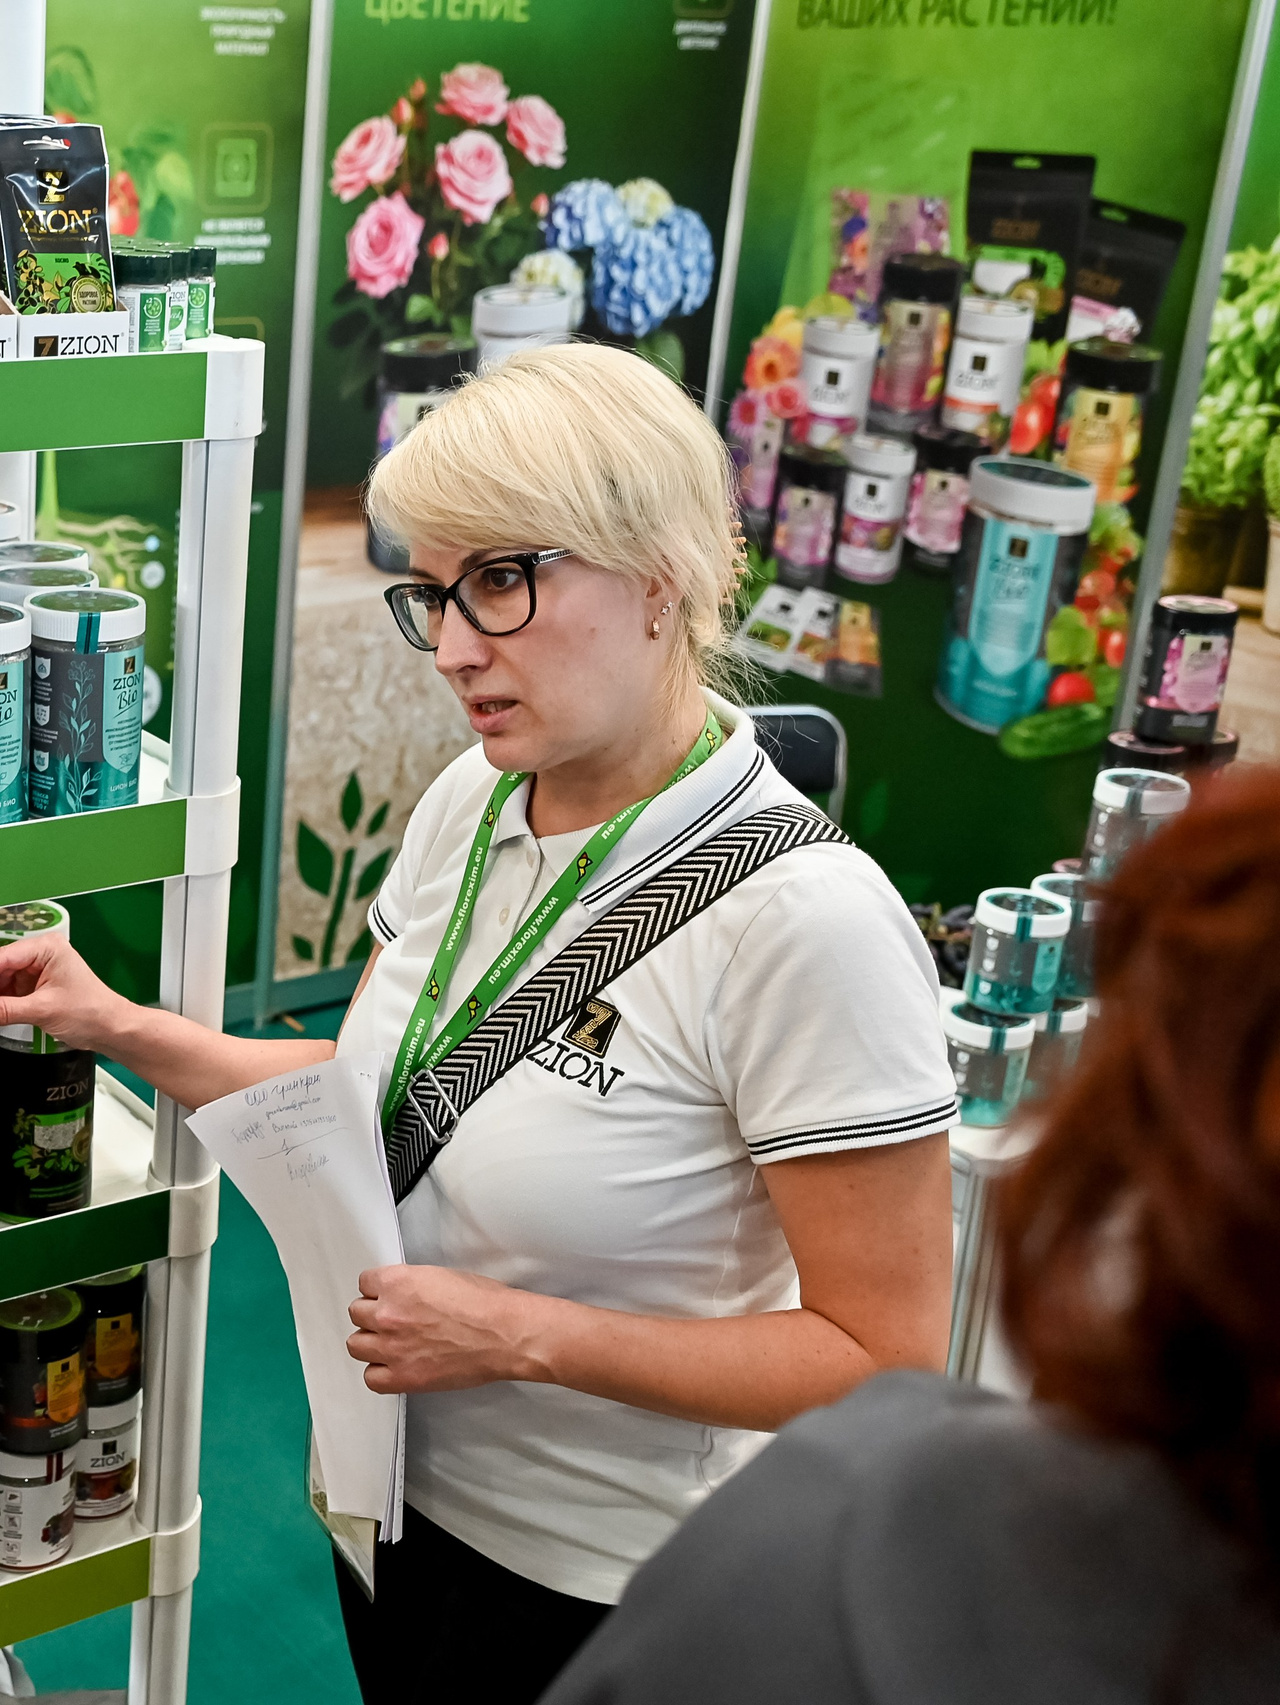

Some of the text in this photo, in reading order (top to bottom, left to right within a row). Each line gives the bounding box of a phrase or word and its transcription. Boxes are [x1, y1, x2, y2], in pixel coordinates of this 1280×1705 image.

[20, 209, 92, 234] ZION
[61, 335, 119, 356] ZION
[113, 673, 141, 690] ZION
[117, 690, 138, 710] Bio
[3, 798, 16, 807] БИО
[445, 846, 483, 952] www.florexim.eu
[487, 896, 559, 985] www.florexim.eu
[525, 1039, 626, 1097] ZION
[46, 1078, 90, 1101] ZION
[90, 1451, 125, 1468] ZION
